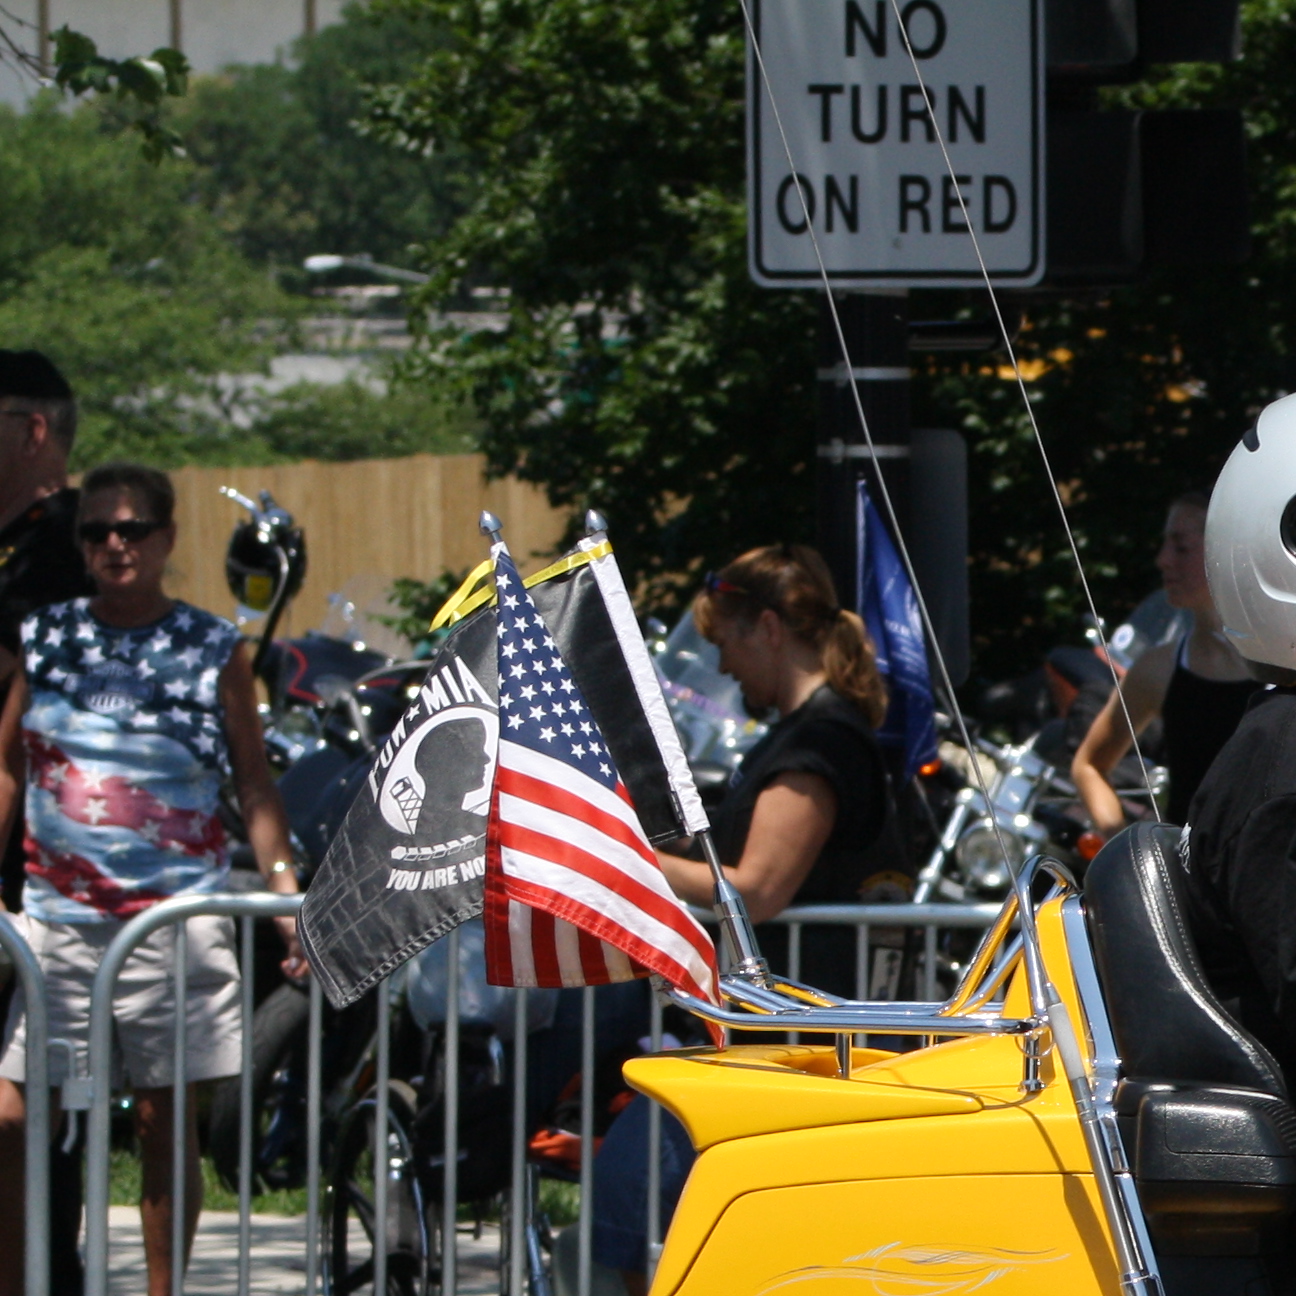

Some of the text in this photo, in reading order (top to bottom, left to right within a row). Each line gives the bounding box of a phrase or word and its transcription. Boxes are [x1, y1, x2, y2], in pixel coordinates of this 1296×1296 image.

[845, 0, 947, 59] NO
[808, 84, 986, 144] TURN
[776, 172, 1018, 235] ON RED
[420, 655, 500, 716] MIA
[385, 854, 486, 891] YOU ARE NO
